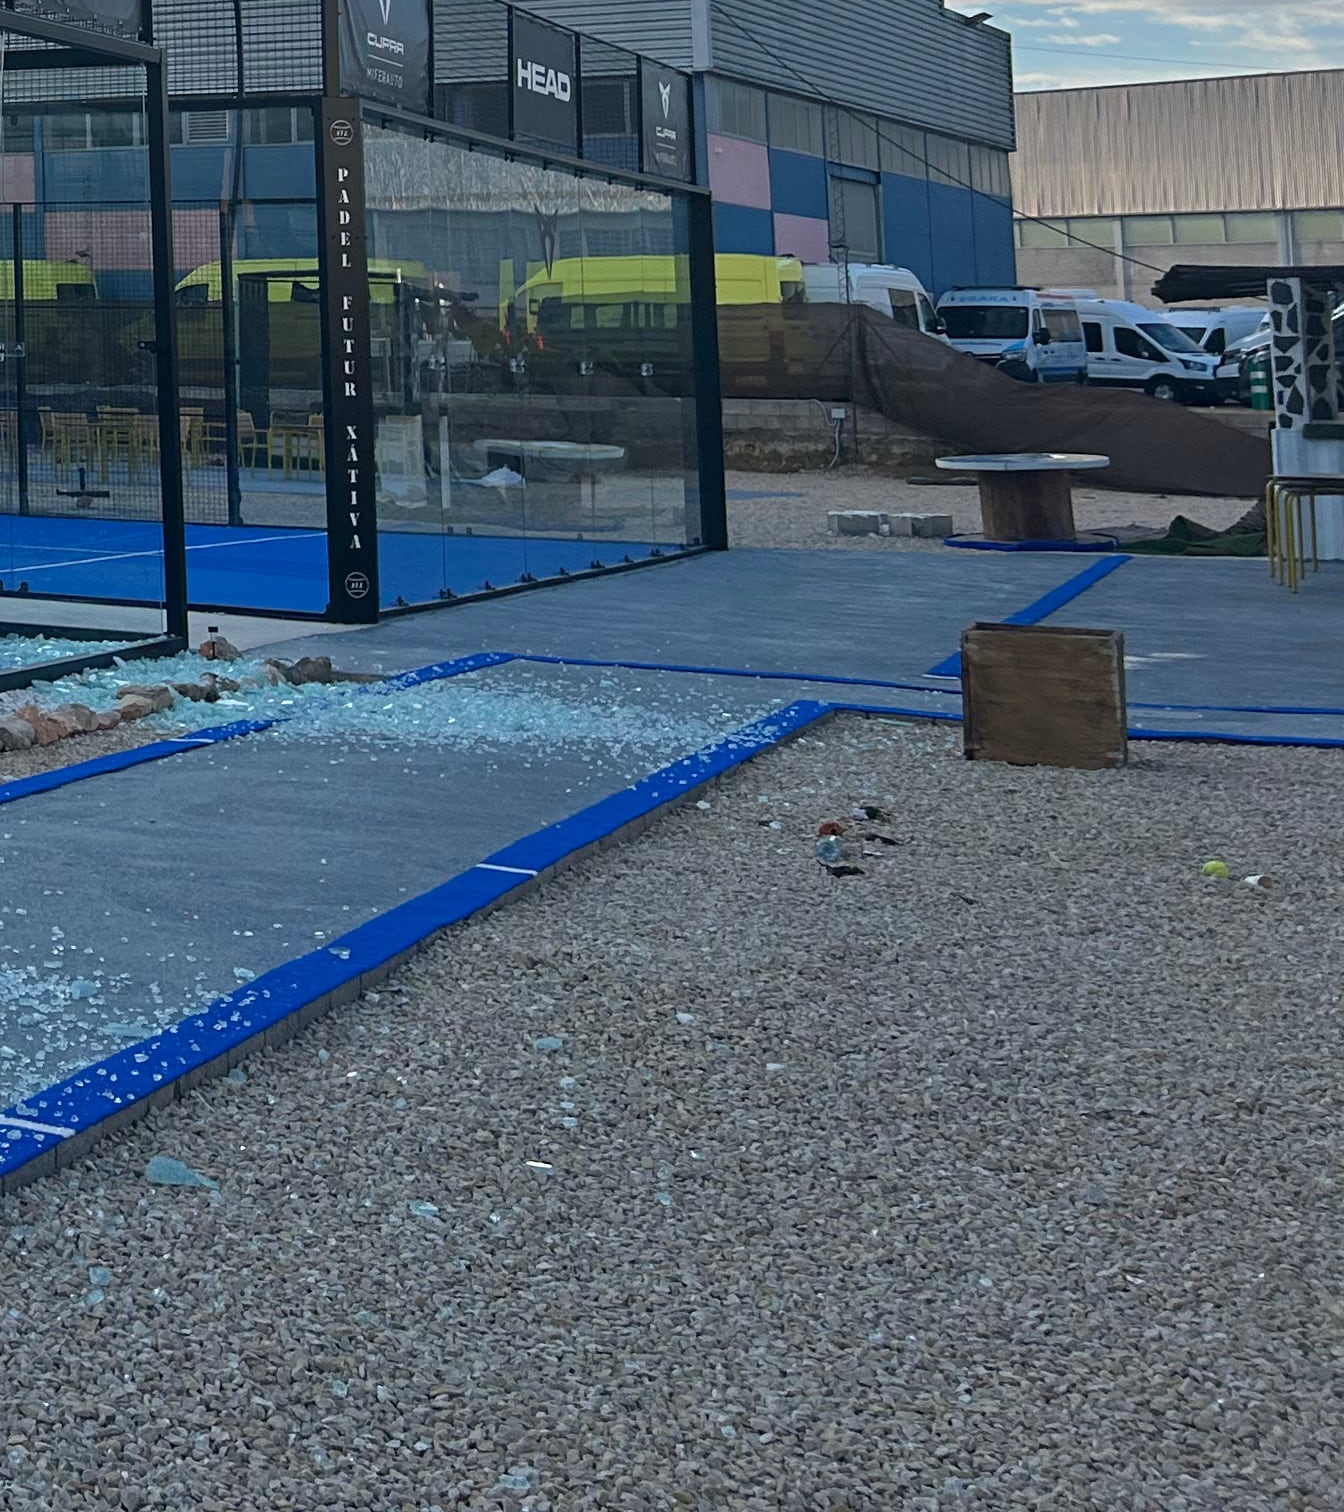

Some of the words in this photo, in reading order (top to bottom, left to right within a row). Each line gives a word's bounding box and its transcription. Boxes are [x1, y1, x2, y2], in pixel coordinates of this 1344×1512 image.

[367, 32, 405, 55] CUPRA
[517, 58, 571, 103] HEAD
[337, 168, 351, 268] PADEL
[342, 296, 356, 397] FUTUR
